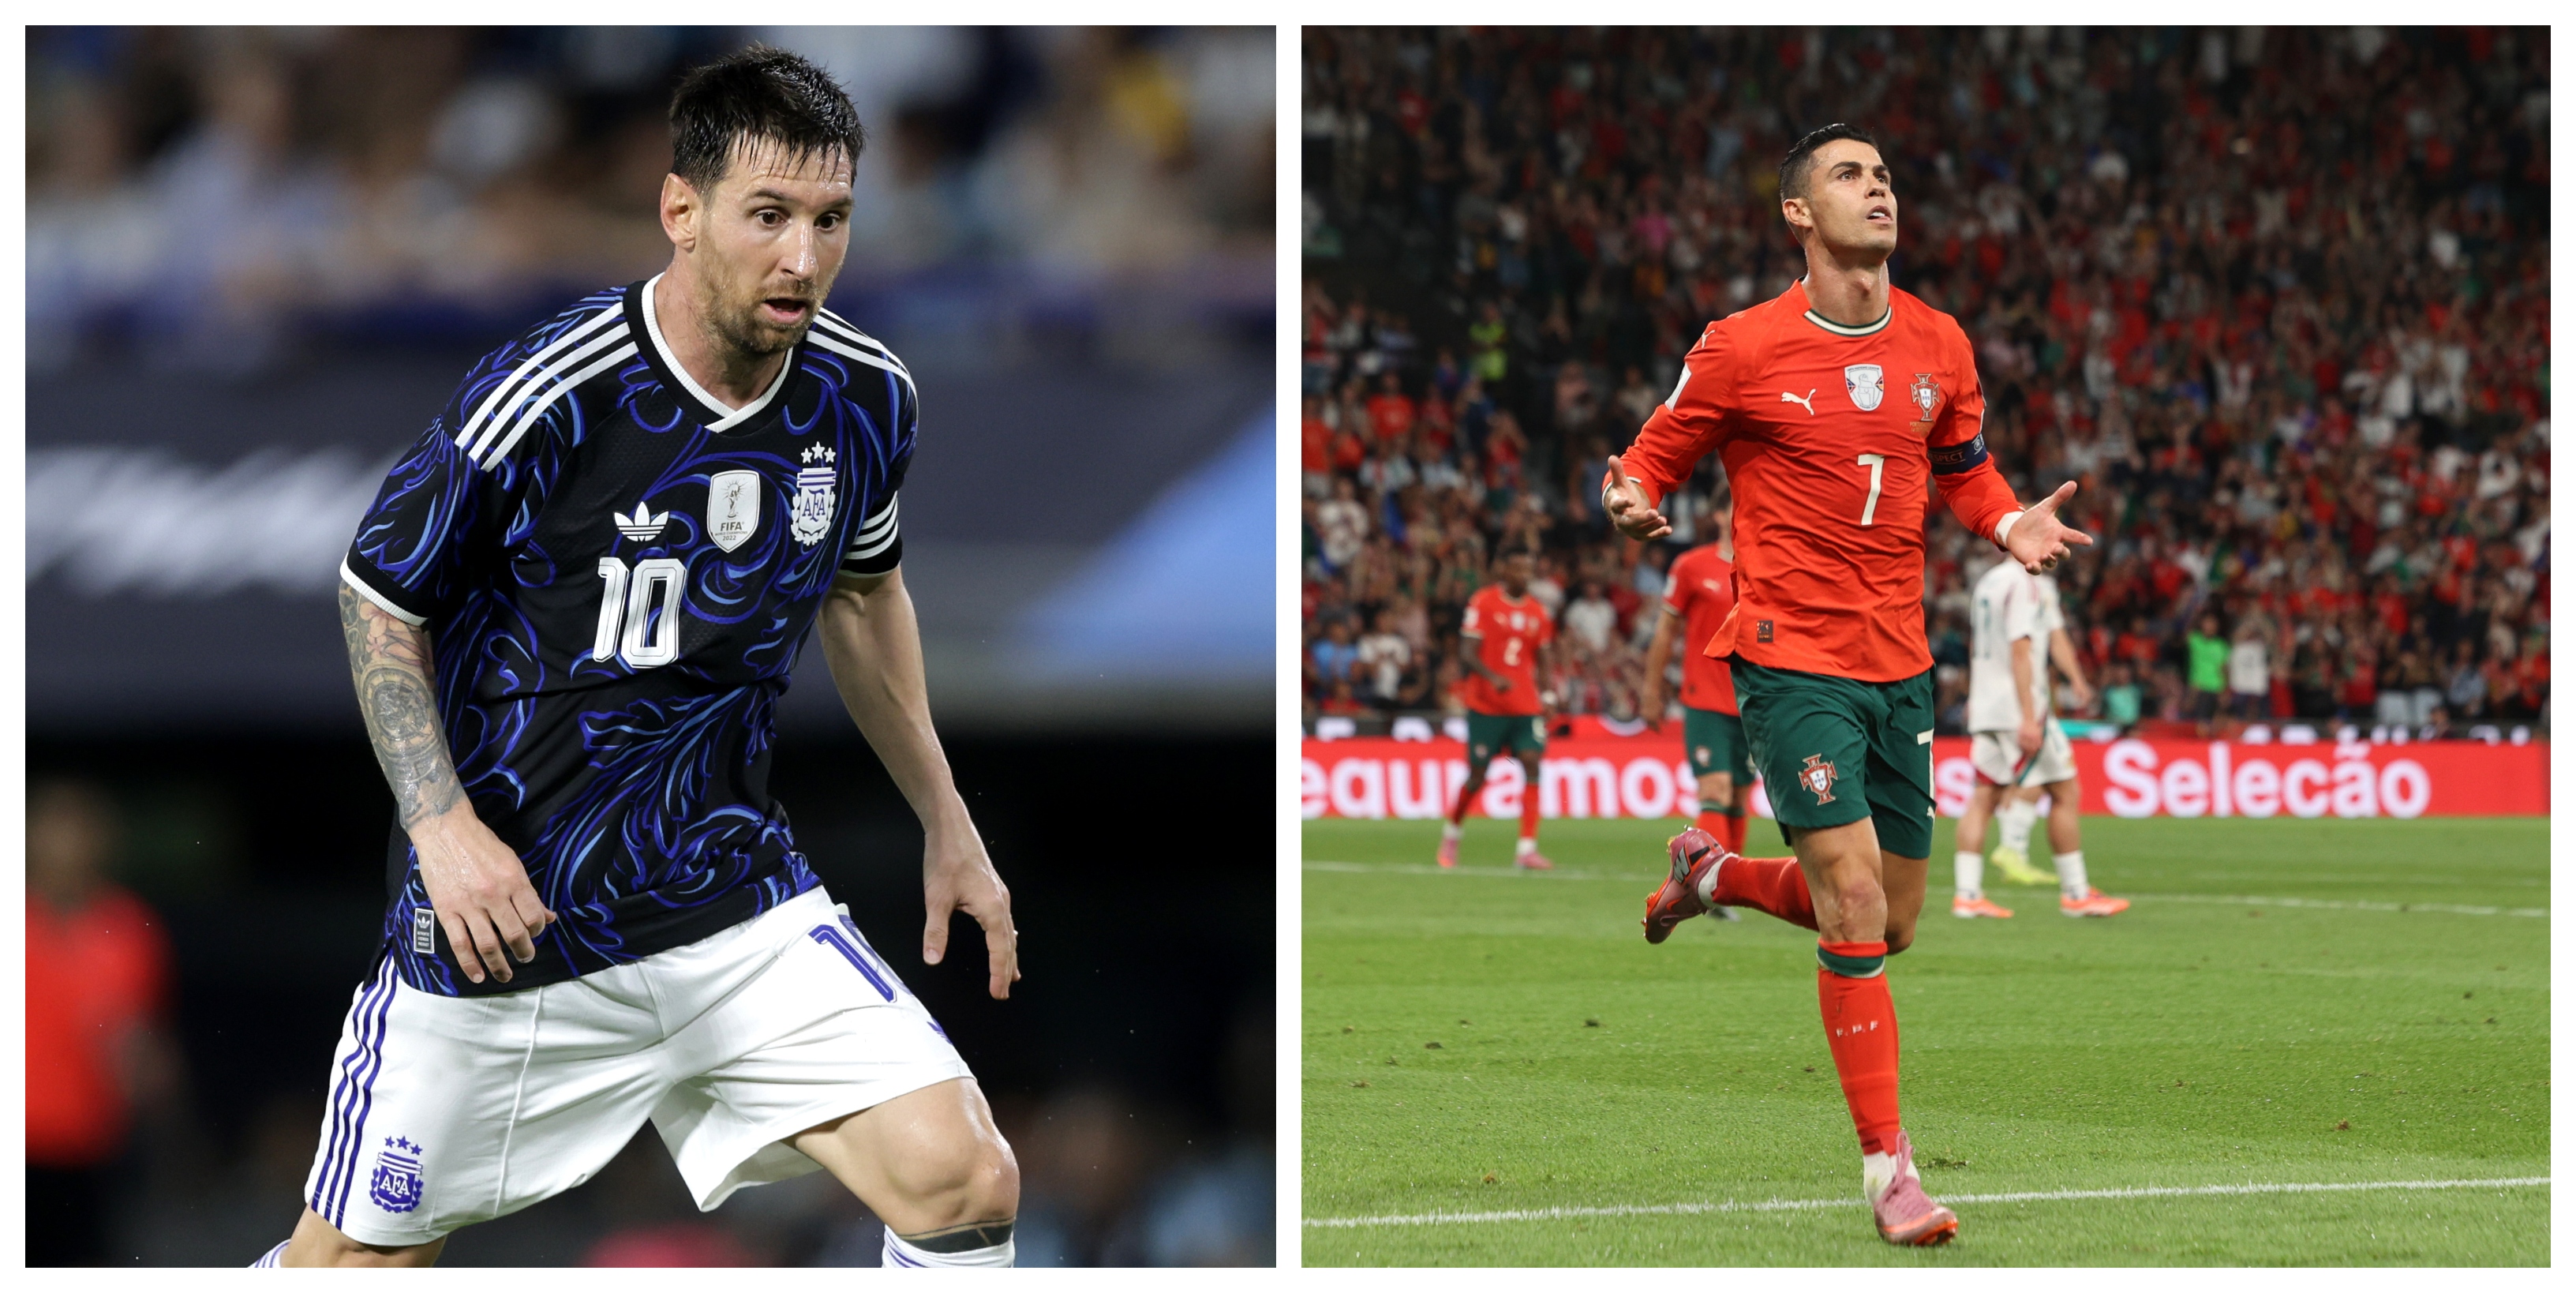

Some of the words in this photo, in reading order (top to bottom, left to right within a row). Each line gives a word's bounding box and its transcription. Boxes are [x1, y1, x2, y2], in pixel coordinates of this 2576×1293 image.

[802, 489, 826, 522] AFA
[1858, 454, 1885, 526] 7
[593, 557, 687, 669] 10
[1503, 636, 1523, 666] 2
[380, 1167, 410, 1198] AFA
